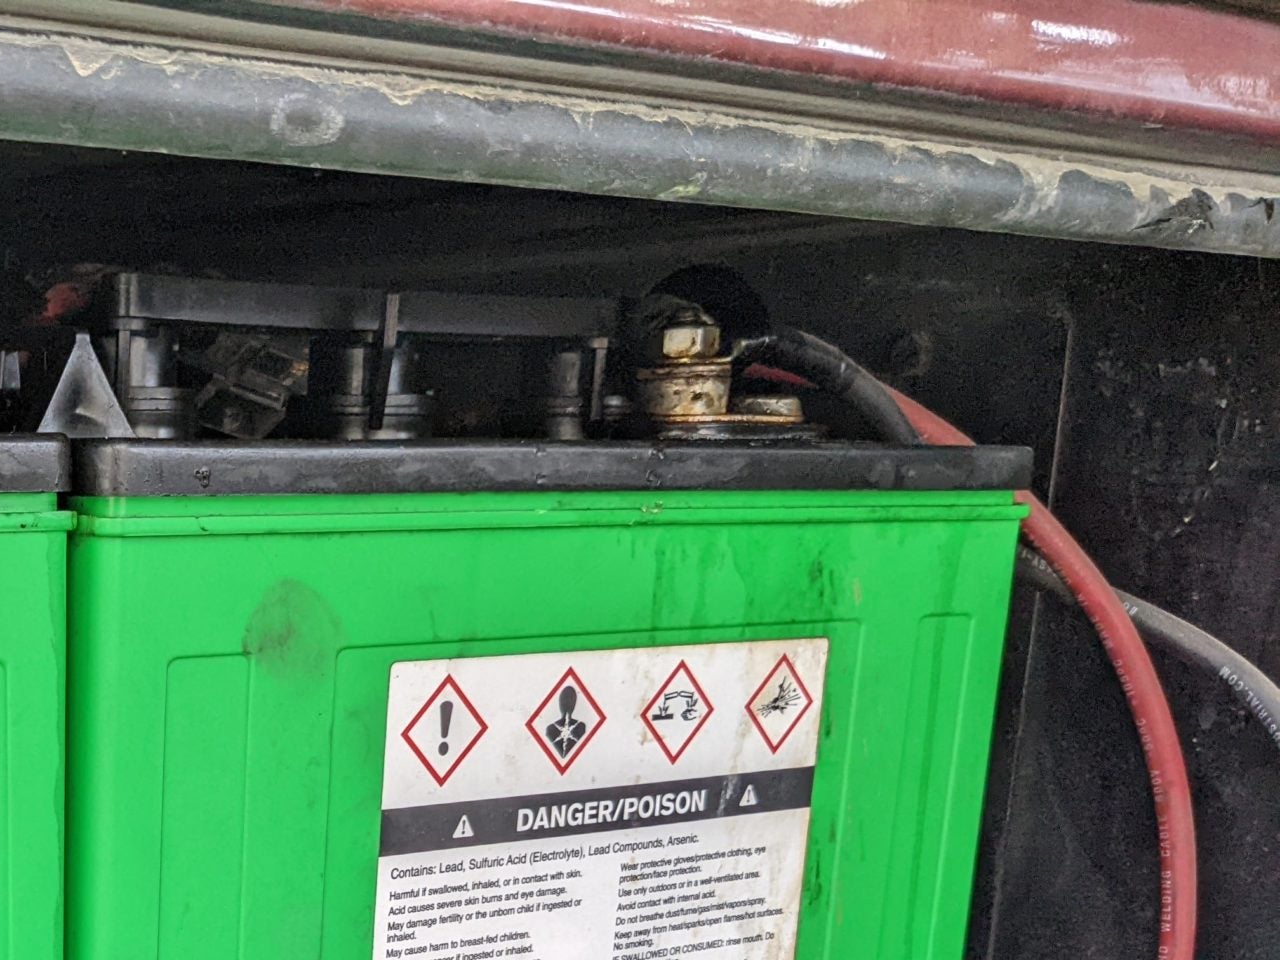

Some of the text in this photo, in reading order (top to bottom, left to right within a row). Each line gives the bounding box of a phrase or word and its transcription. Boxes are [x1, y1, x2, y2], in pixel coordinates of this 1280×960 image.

[516, 788, 706, 833] DANGER/POISON
[390, 835, 699, 880] Contains: Lead, Sulfuric Acid (Electrolyte), Lead Compounds, Arsenic.
[389, 888, 420, 901] Harmful
[421, 887, 427, 897] if
[502, 878, 512, 887] or
[512, 876, 520, 885] in
[521, 873, 549, 885] contact
[549, 871, 565, 881] with
[1160, 870, 1172, 932] WELDING
[388, 905, 406, 916] Acid
[407, 903, 435, 914] causes
[436, 899, 463, 910] severe
[464, 896, 480, 906] skin
[481, 894, 503, 904] burns
[504, 891, 520, 901] and
[520, 890, 535, 901] eye
[386, 948, 403, 959] May
[404, 945, 428, 956] cause
[429, 942, 449, 952] harm
[450, 940, 459, 949] to
[459, 934, 499, 948] breast-fed
[495, 949, 504, 958] or
